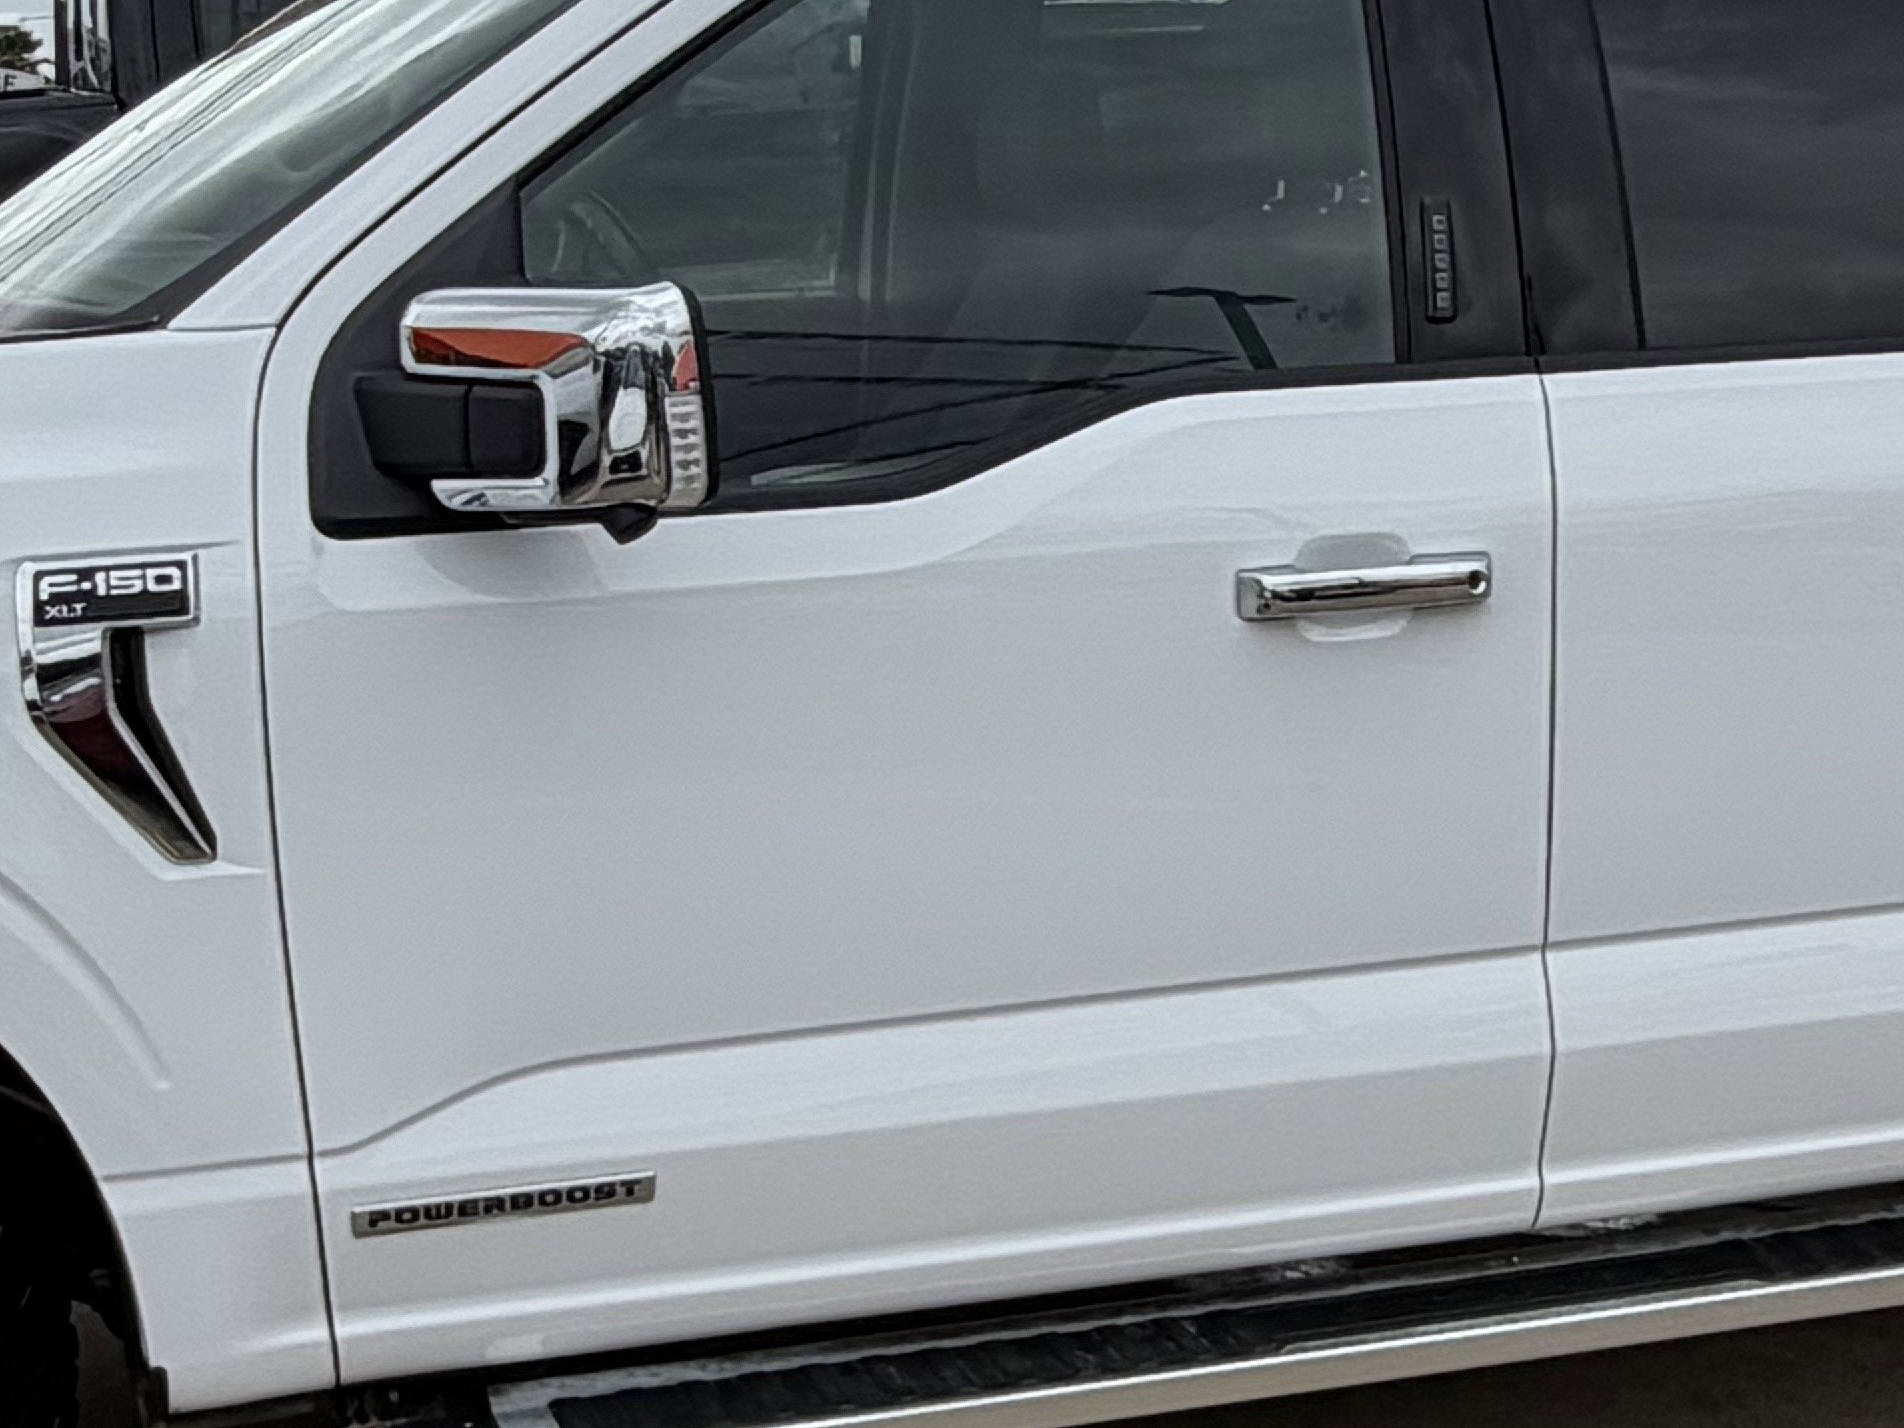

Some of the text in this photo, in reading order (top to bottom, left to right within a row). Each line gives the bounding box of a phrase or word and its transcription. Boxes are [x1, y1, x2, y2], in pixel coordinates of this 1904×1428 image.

[39, 566, 182, 602] F-150
[44, 603, 88, 620] XLT
[367, 1178, 642, 1228] POWERBOOST
